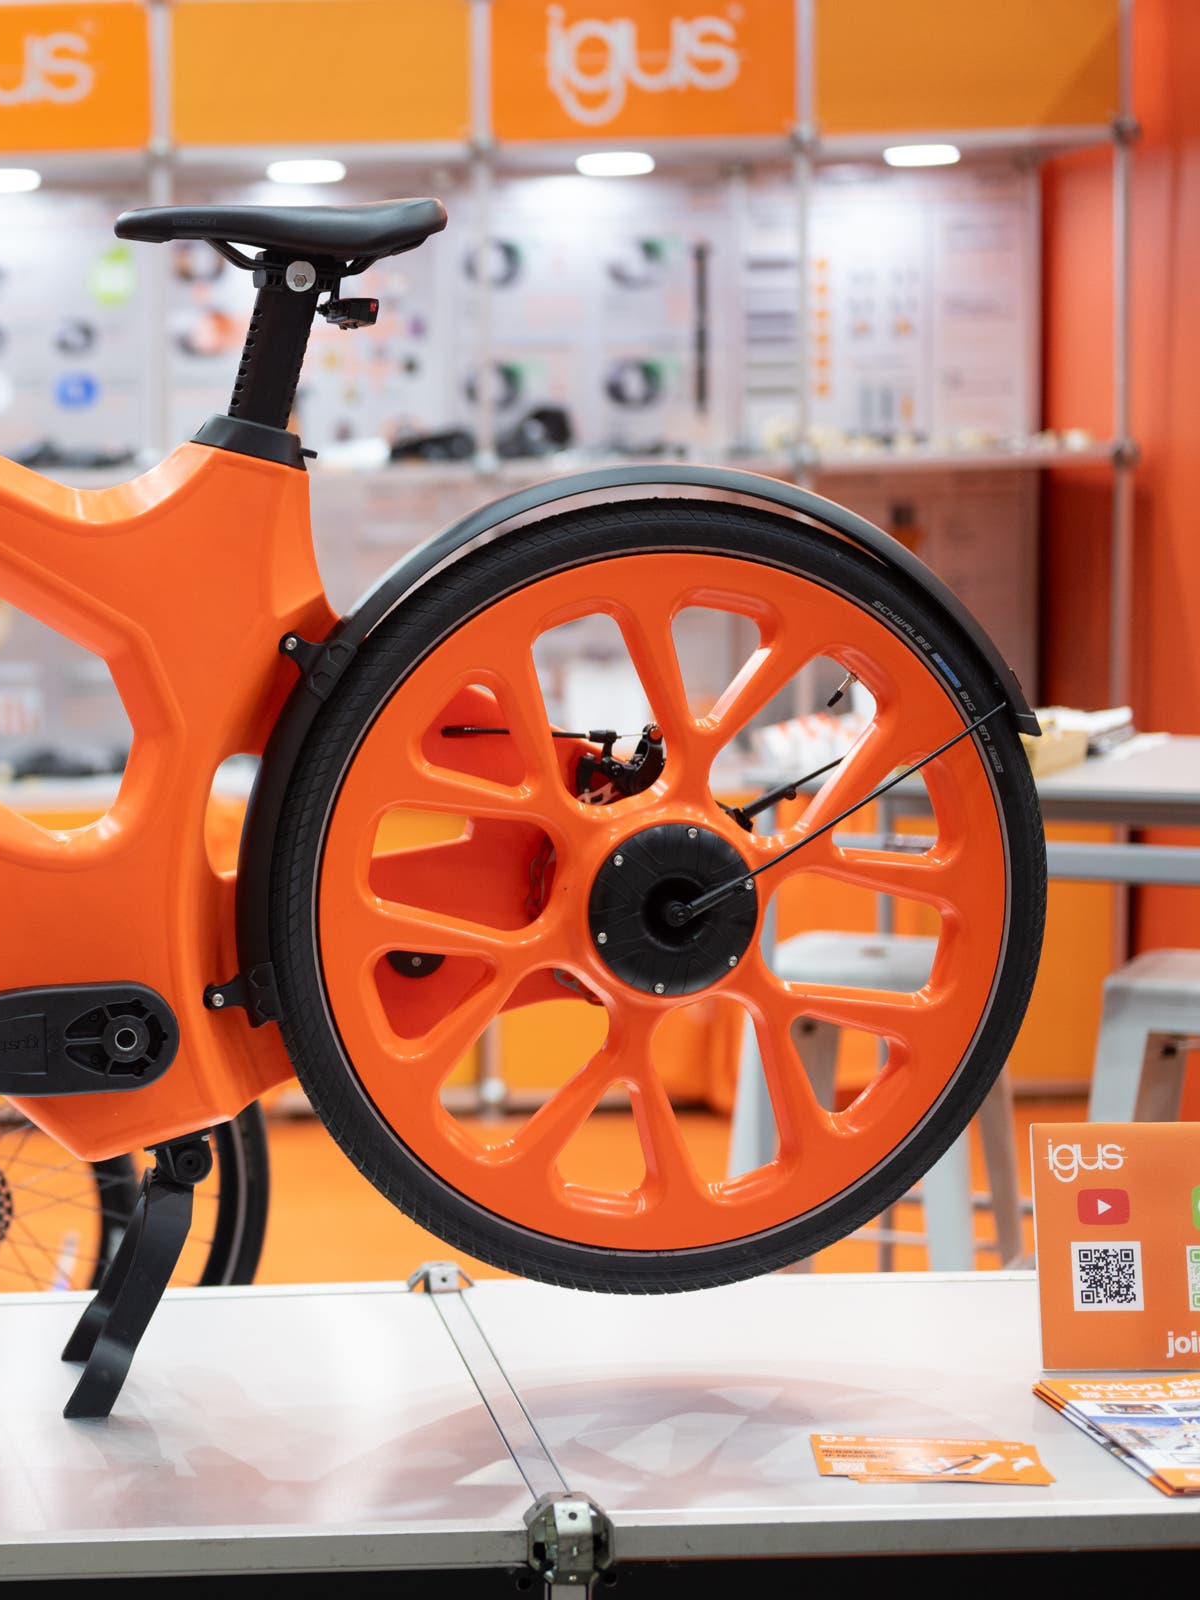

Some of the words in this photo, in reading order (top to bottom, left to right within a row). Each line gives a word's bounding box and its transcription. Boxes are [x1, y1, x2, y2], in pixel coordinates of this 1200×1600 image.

[546, 4, 740, 124] igus
[871, 600, 933, 651] SCHWALBE
[959, 690, 977, 712] BIG
[1047, 1138, 1124, 1182] igus
[1166, 1330, 1200, 1359] joi
[1068, 1382, 1164, 1392] motion
